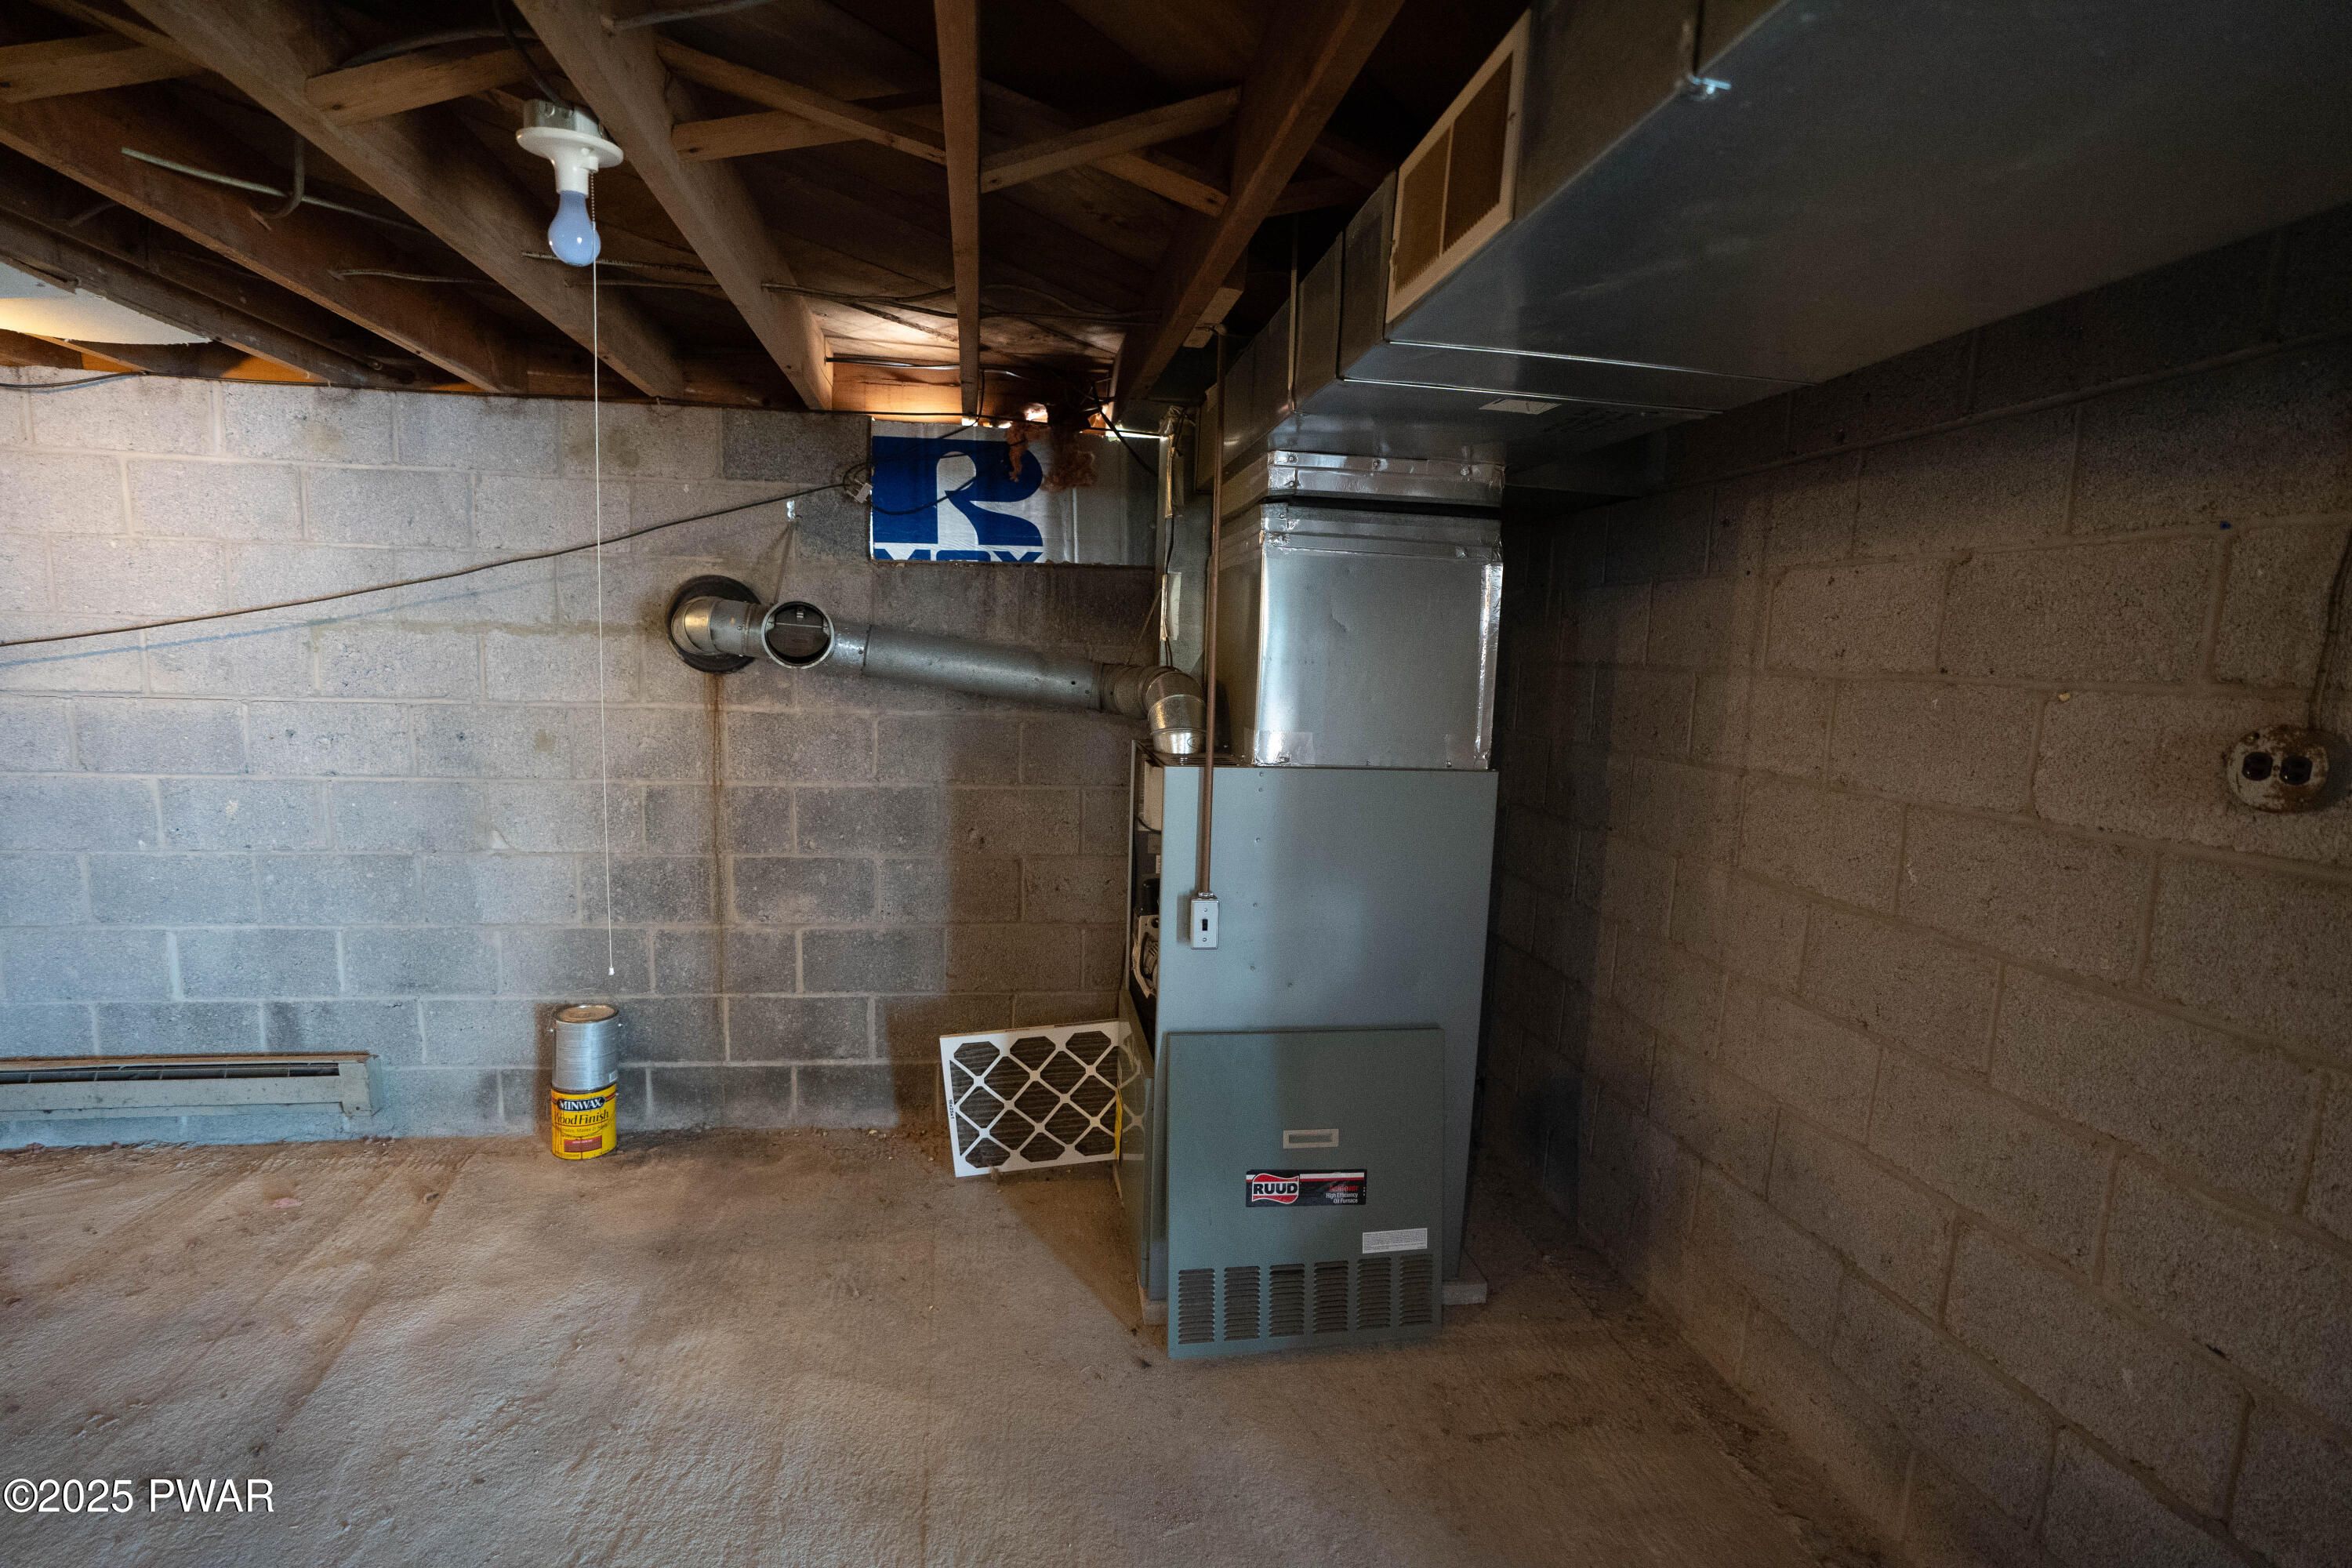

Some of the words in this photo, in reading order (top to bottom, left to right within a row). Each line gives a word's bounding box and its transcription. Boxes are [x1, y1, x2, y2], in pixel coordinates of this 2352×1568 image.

[559, 1098, 601, 1110] MINWAX
[579, 1109, 608, 1124] Finish
[1253, 1183, 1298, 1194] RUUD
